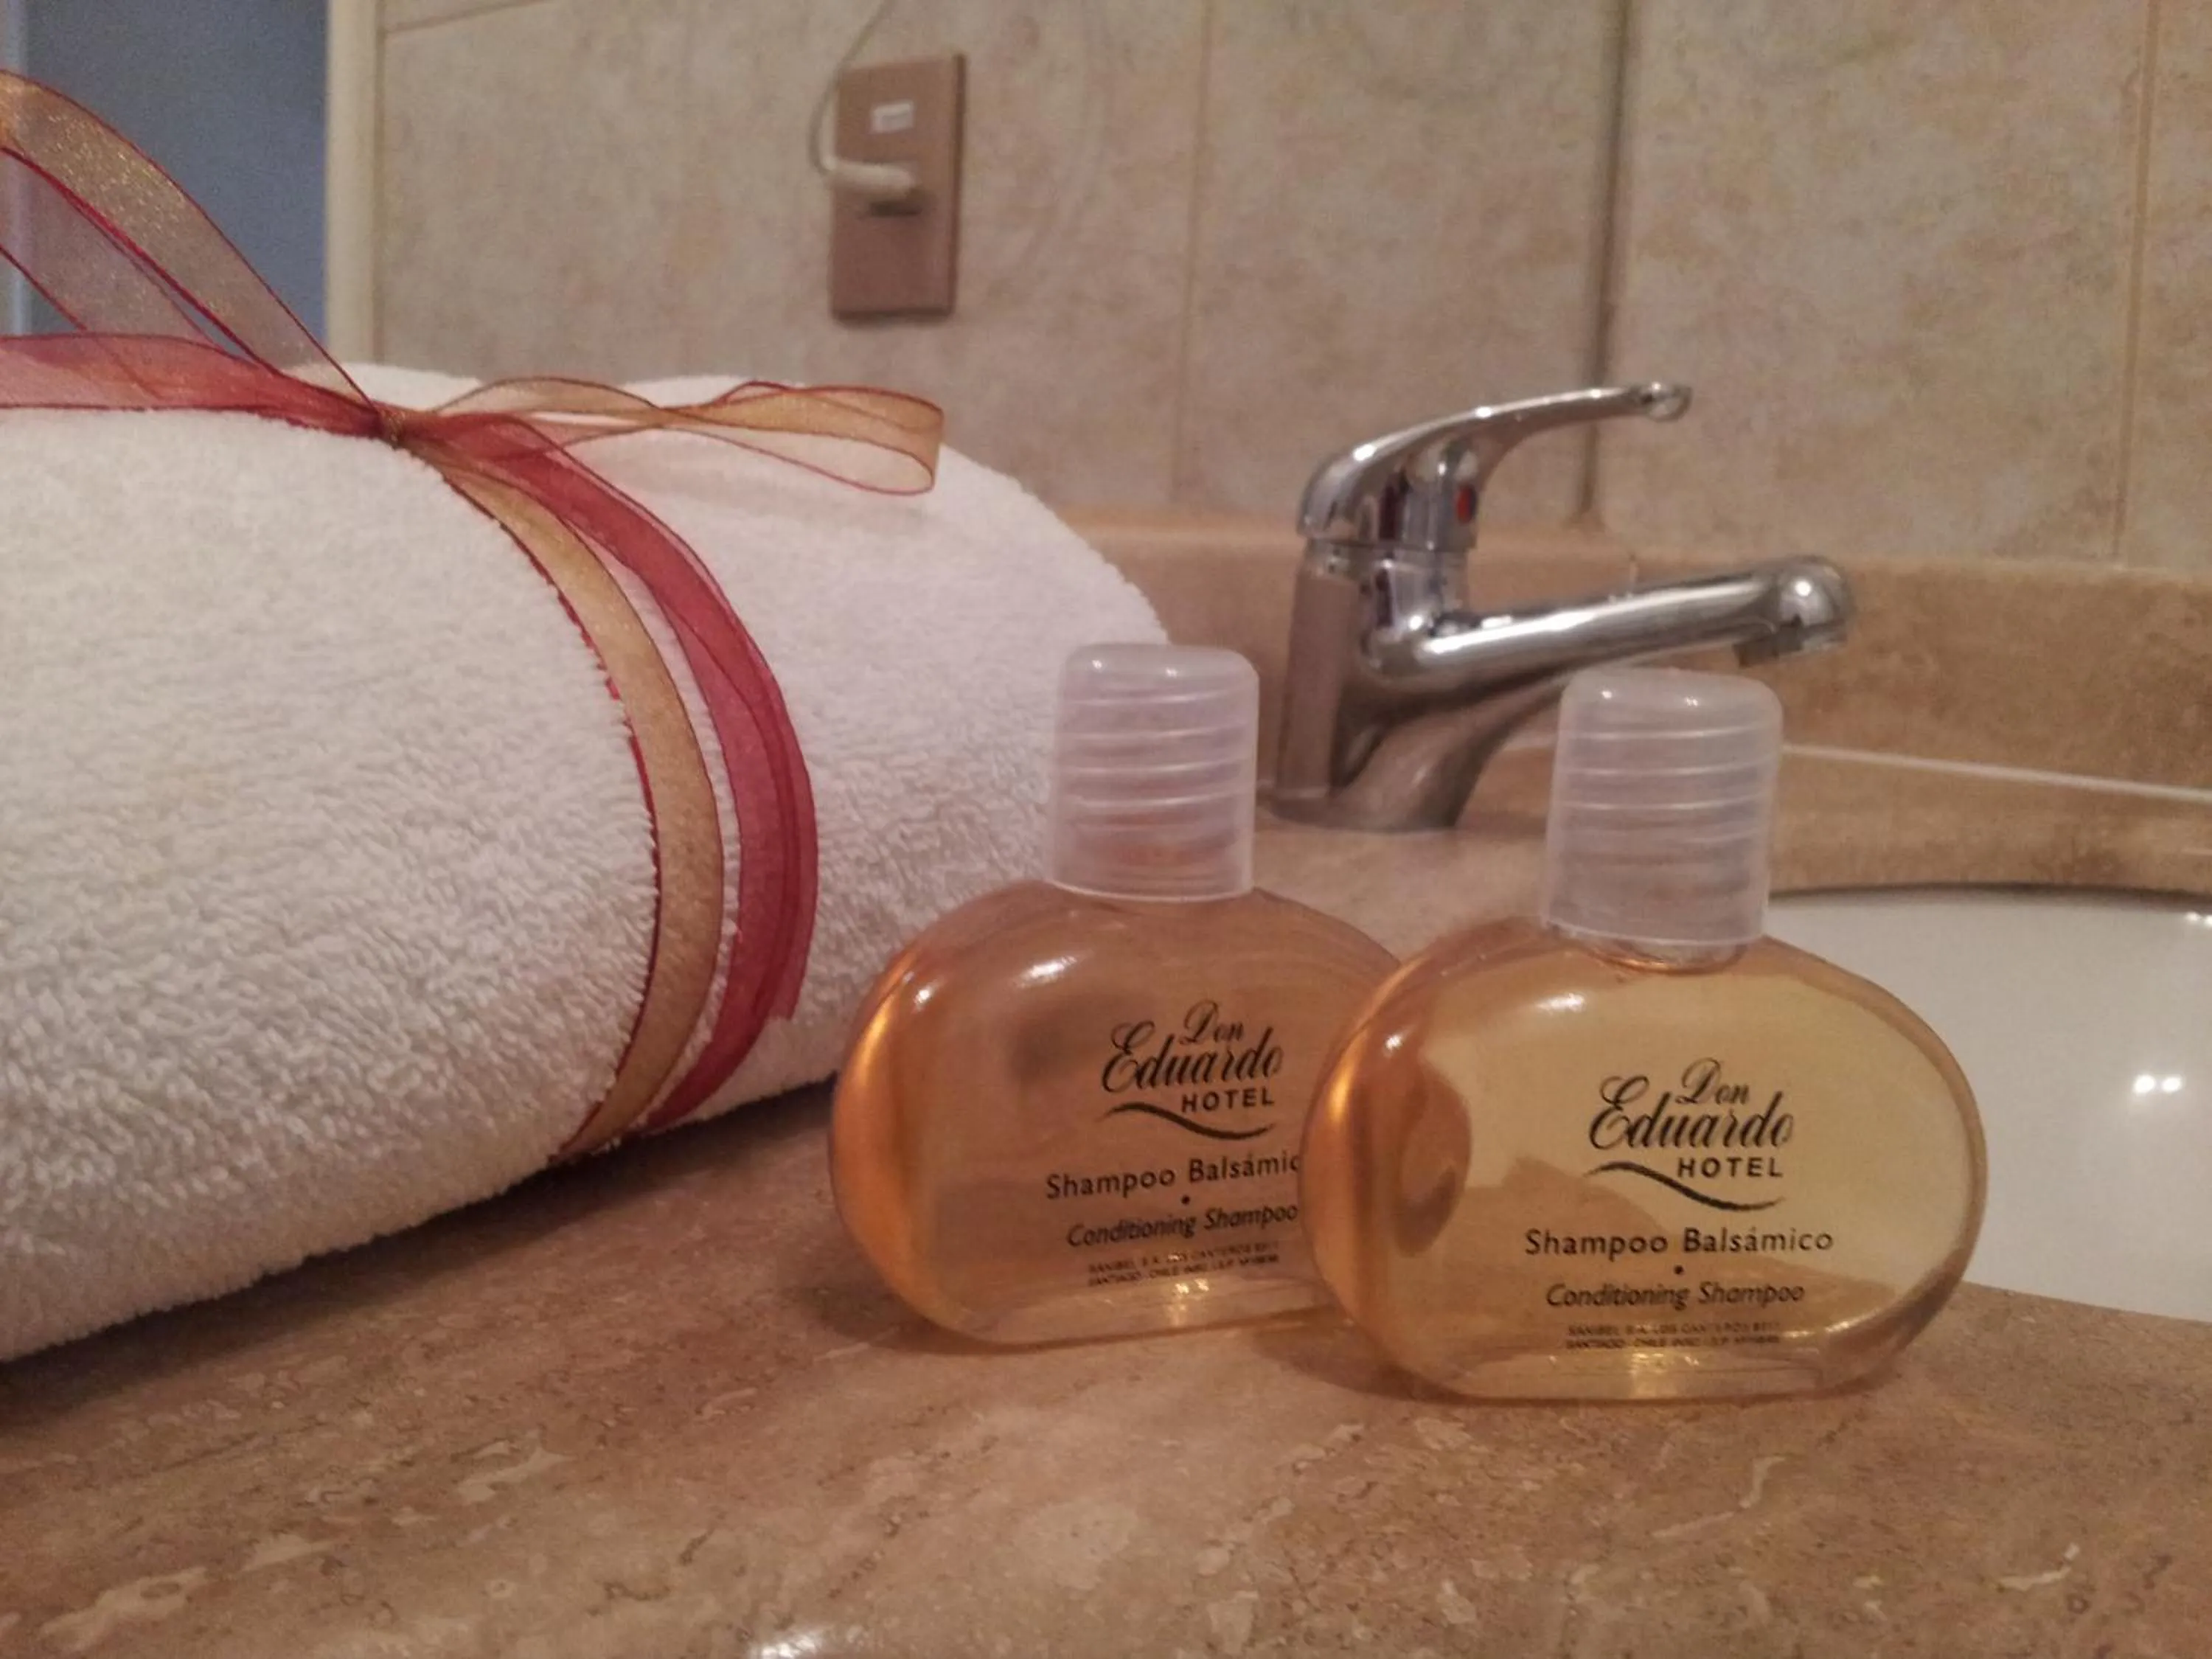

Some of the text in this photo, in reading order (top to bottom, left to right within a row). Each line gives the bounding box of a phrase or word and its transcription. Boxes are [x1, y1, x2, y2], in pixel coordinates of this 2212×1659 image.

[1102, 1020, 1284, 1093] Eduardo
[1181, 1088, 1274, 1113] HOTEL
[1674, 1057, 1750, 1105] Don
[1588, 1074, 1794, 1150] Eduardo
[1046, 1150, 1300, 1200] Shampoo Balsámic
[1677, 1156, 1783, 1178] HOTEL
[1066, 1204, 1298, 1247] Conditioning Shampoo
[1524, 1226, 1834, 1262] Shampoo Balsámico
[1546, 1281, 1805, 1311] Conditioning Shampoo
